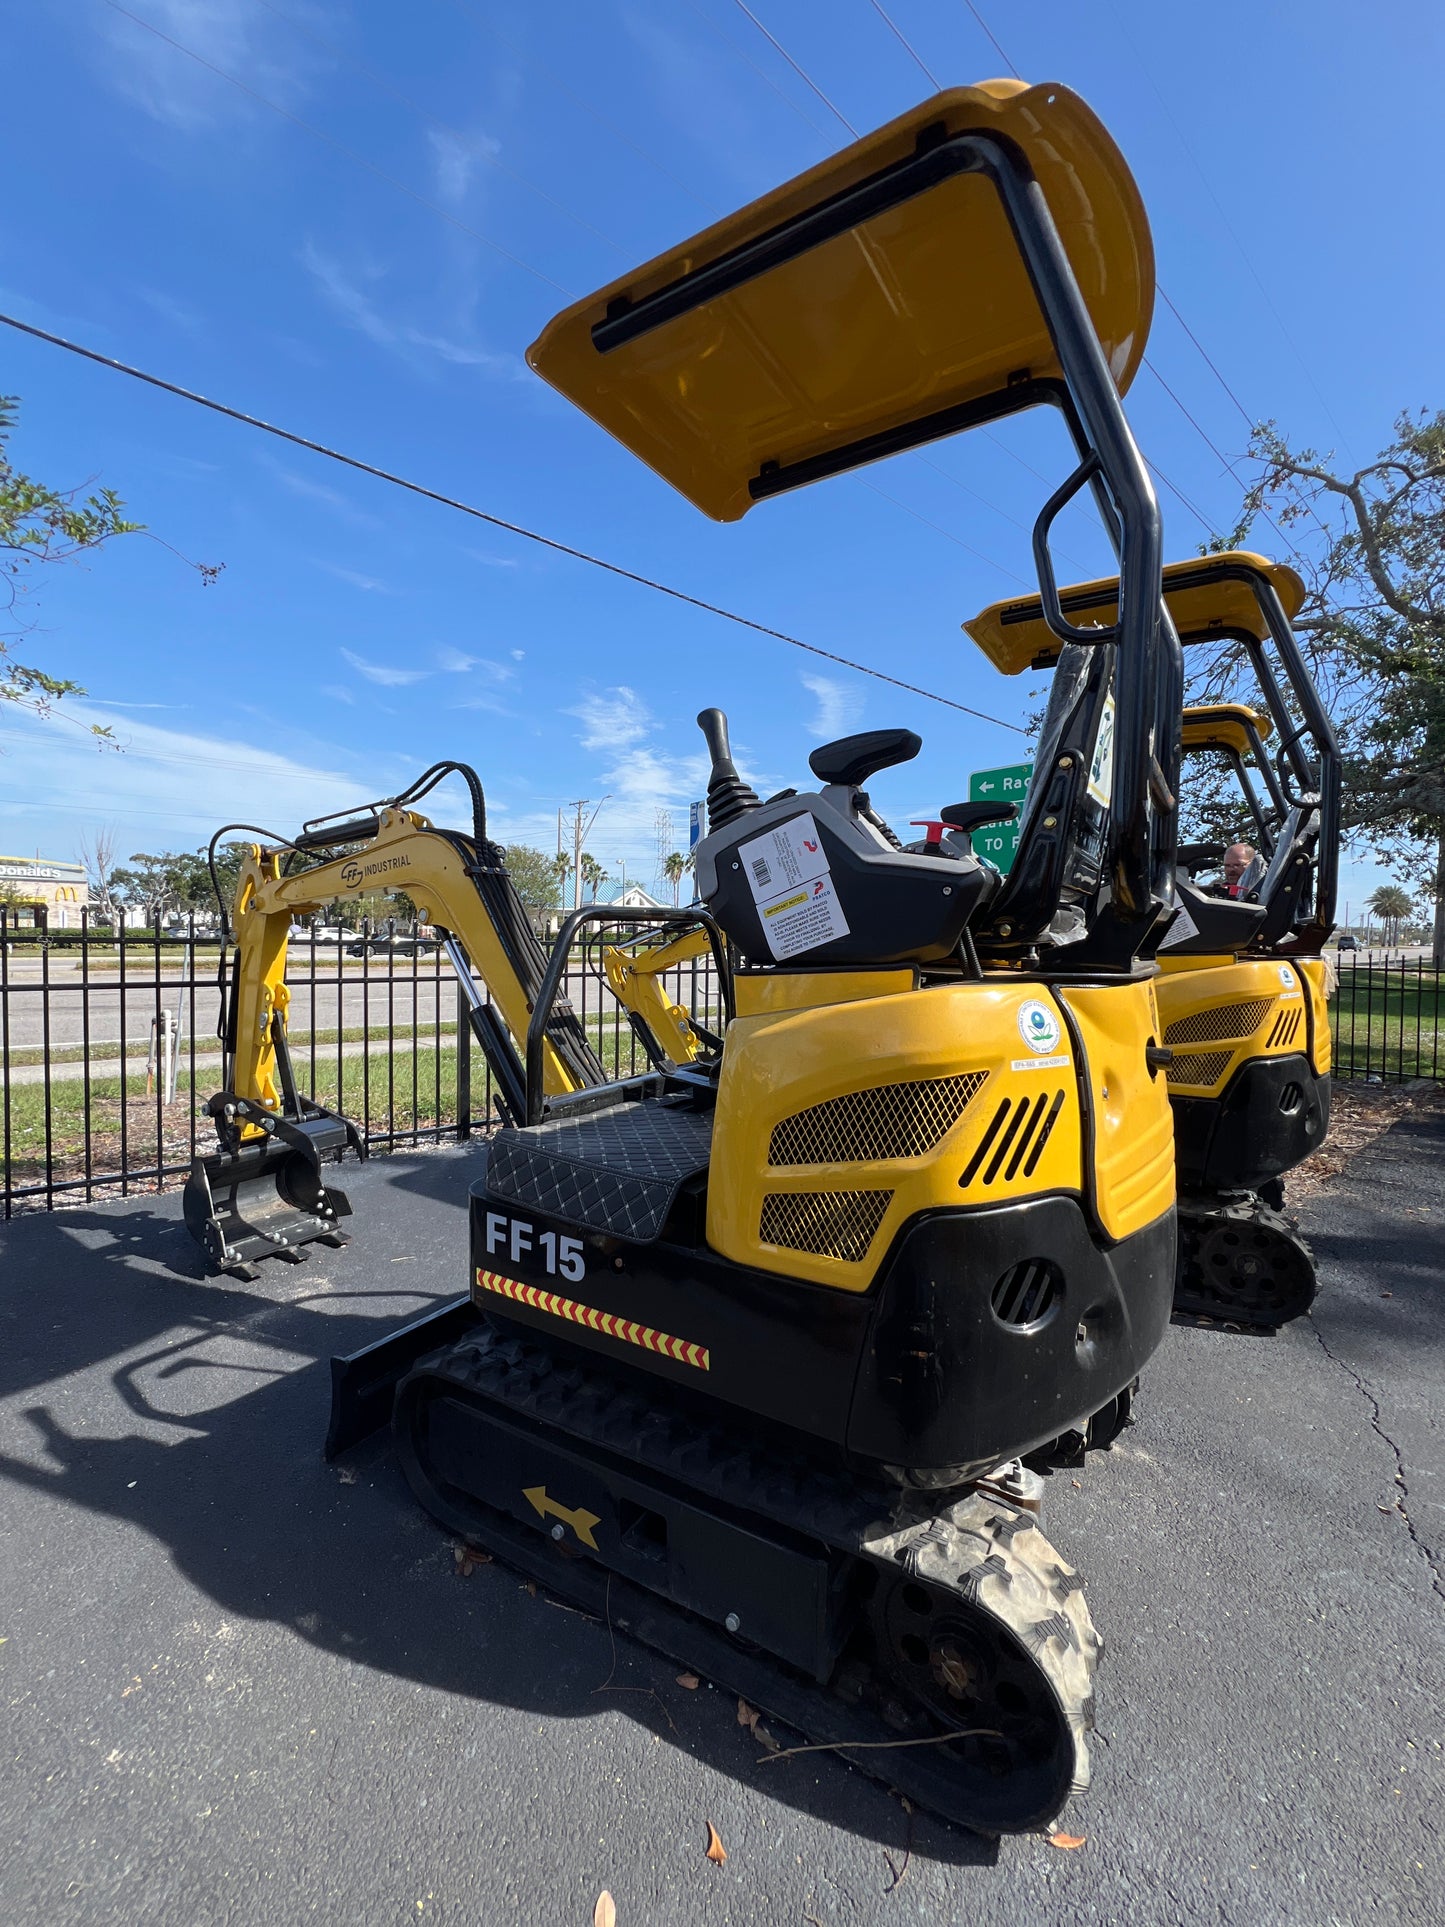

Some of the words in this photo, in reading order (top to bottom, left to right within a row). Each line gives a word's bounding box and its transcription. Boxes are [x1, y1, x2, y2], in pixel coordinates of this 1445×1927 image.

[985, 838, 1003, 851] TO
[364, 854, 411, 877] INDUSTRIAL
[812, 890, 831, 901] PRATCO
[766, 902, 788, 915] IMPORTANT
